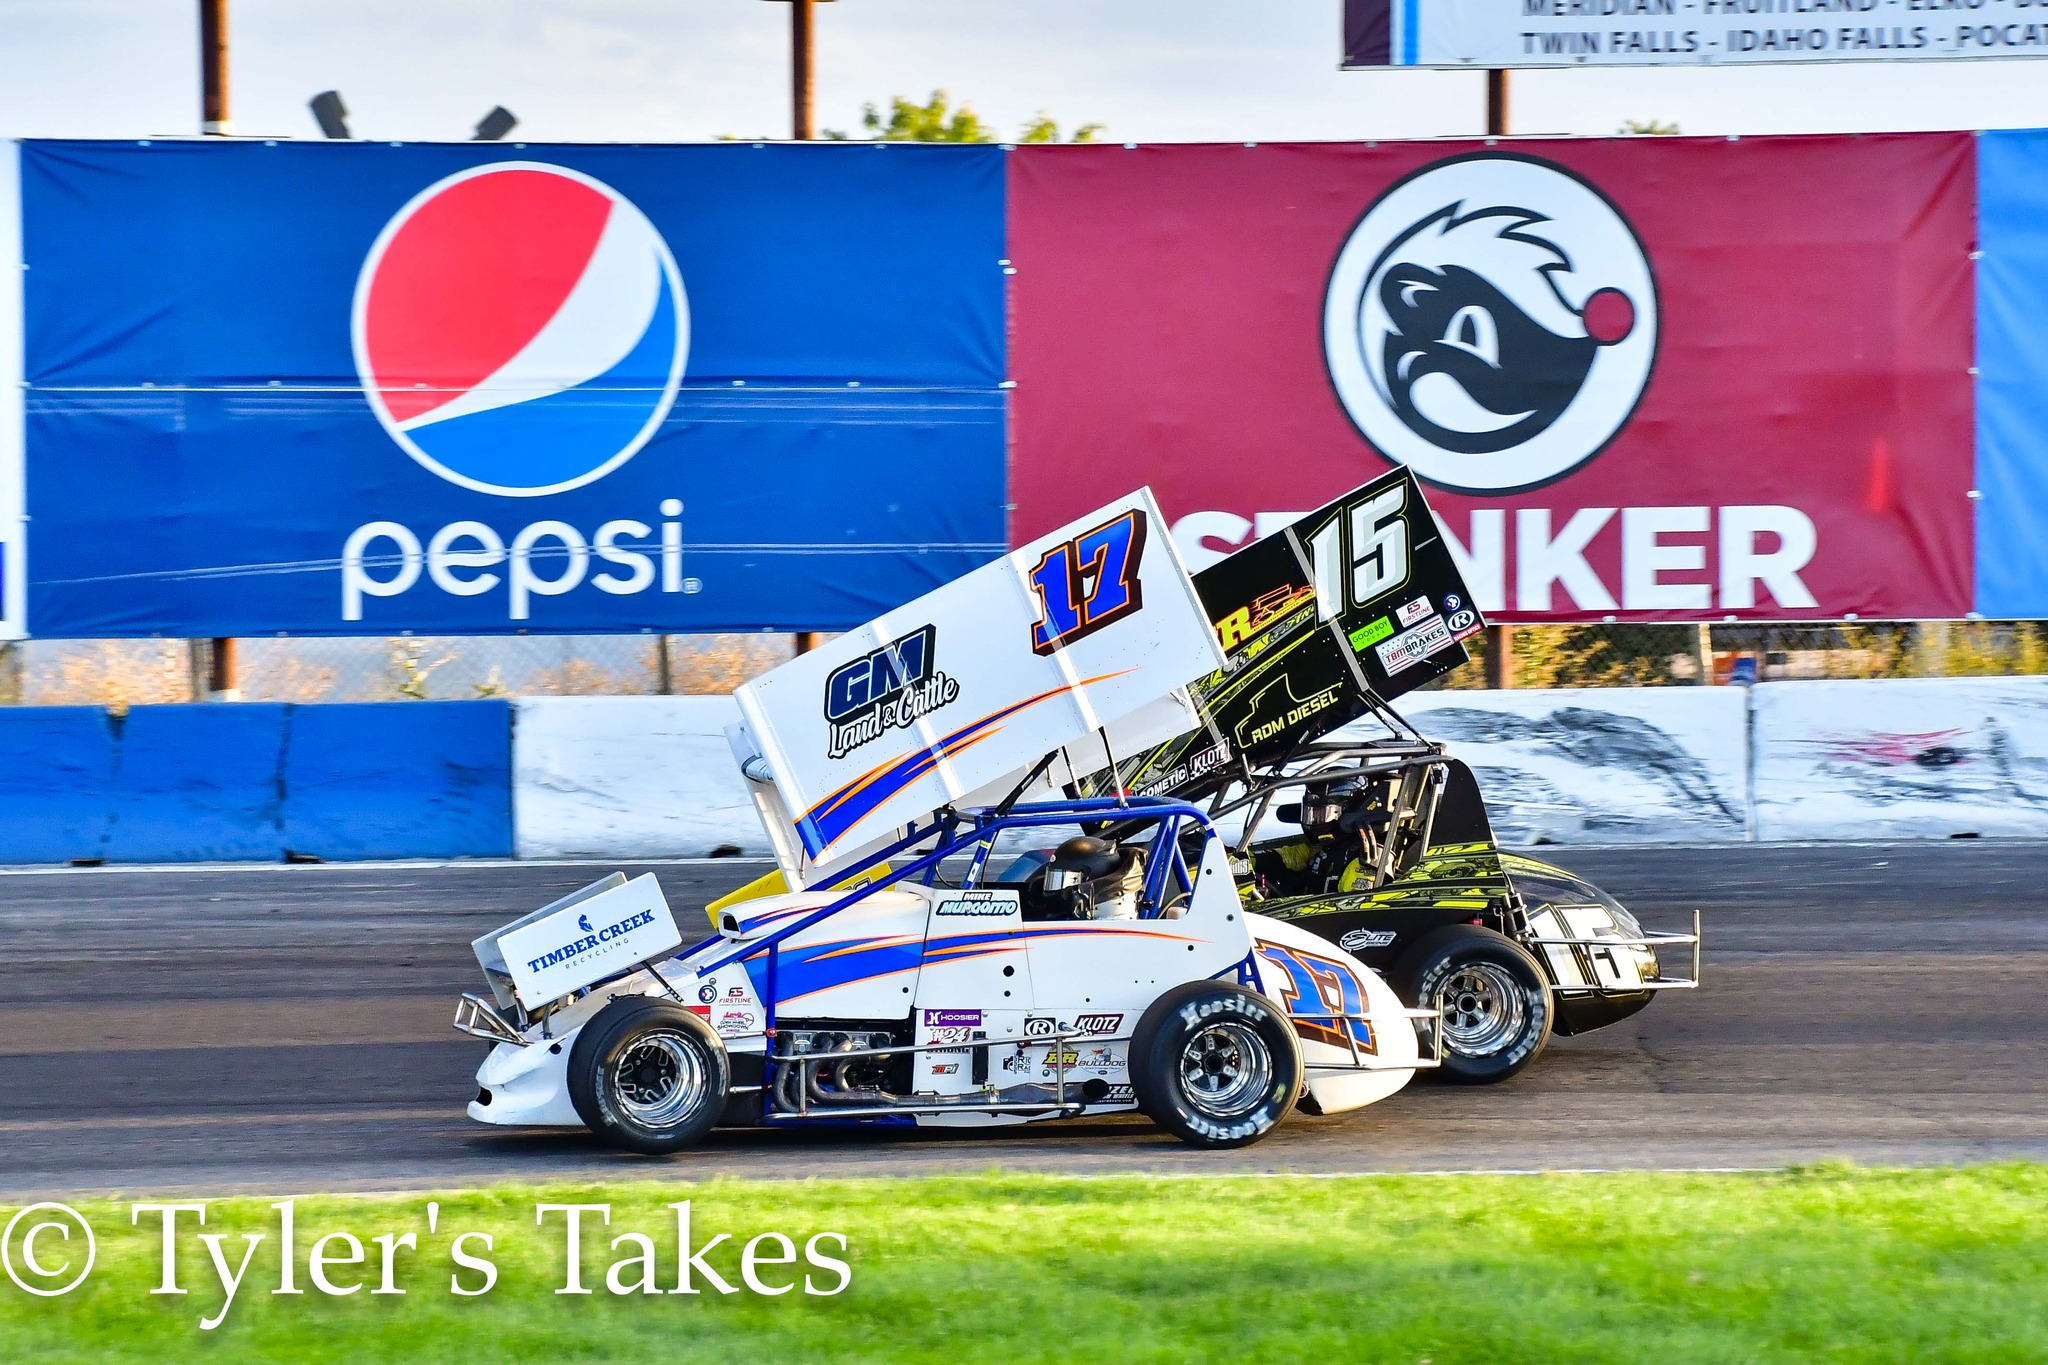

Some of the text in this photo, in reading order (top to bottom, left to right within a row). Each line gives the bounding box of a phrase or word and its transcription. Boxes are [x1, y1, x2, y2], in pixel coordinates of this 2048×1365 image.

[1521, 0, 1677, 16] MERIDIAN
[1703, 0, 1876, 14] FRUITLAND
[1521, 32, 1602, 54] TWIN
[1609, 30, 1699, 53] FALLS
[1727, 28, 1829, 52] IDAHO
[1837, 26, 1928, 50] FALLS
[341, 498, 684, 621] pepsi
[1308, 481, 1410, 624] 15
[1030, 511, 1143, 654] 17
[1352, 620, 1388, 643] GOOD BOY
[826, 628, 930, 721] GM
[829, 702, 883, 758] Land
[895, 673, 959, 728] Cattle
[1288, 690, 1339, 726] DIESEL
[1194, 743, 1227, 770] KLOTZ
[963, 892, 992, 901] MIKE
[527, 909, 656, 973] TIMBER CREEK
[565, 938, 630, 970] RECYCLING
[1255, 939, 1376, 1054] 17
[1080, 1016, 1120, 1031] KLOTZ
